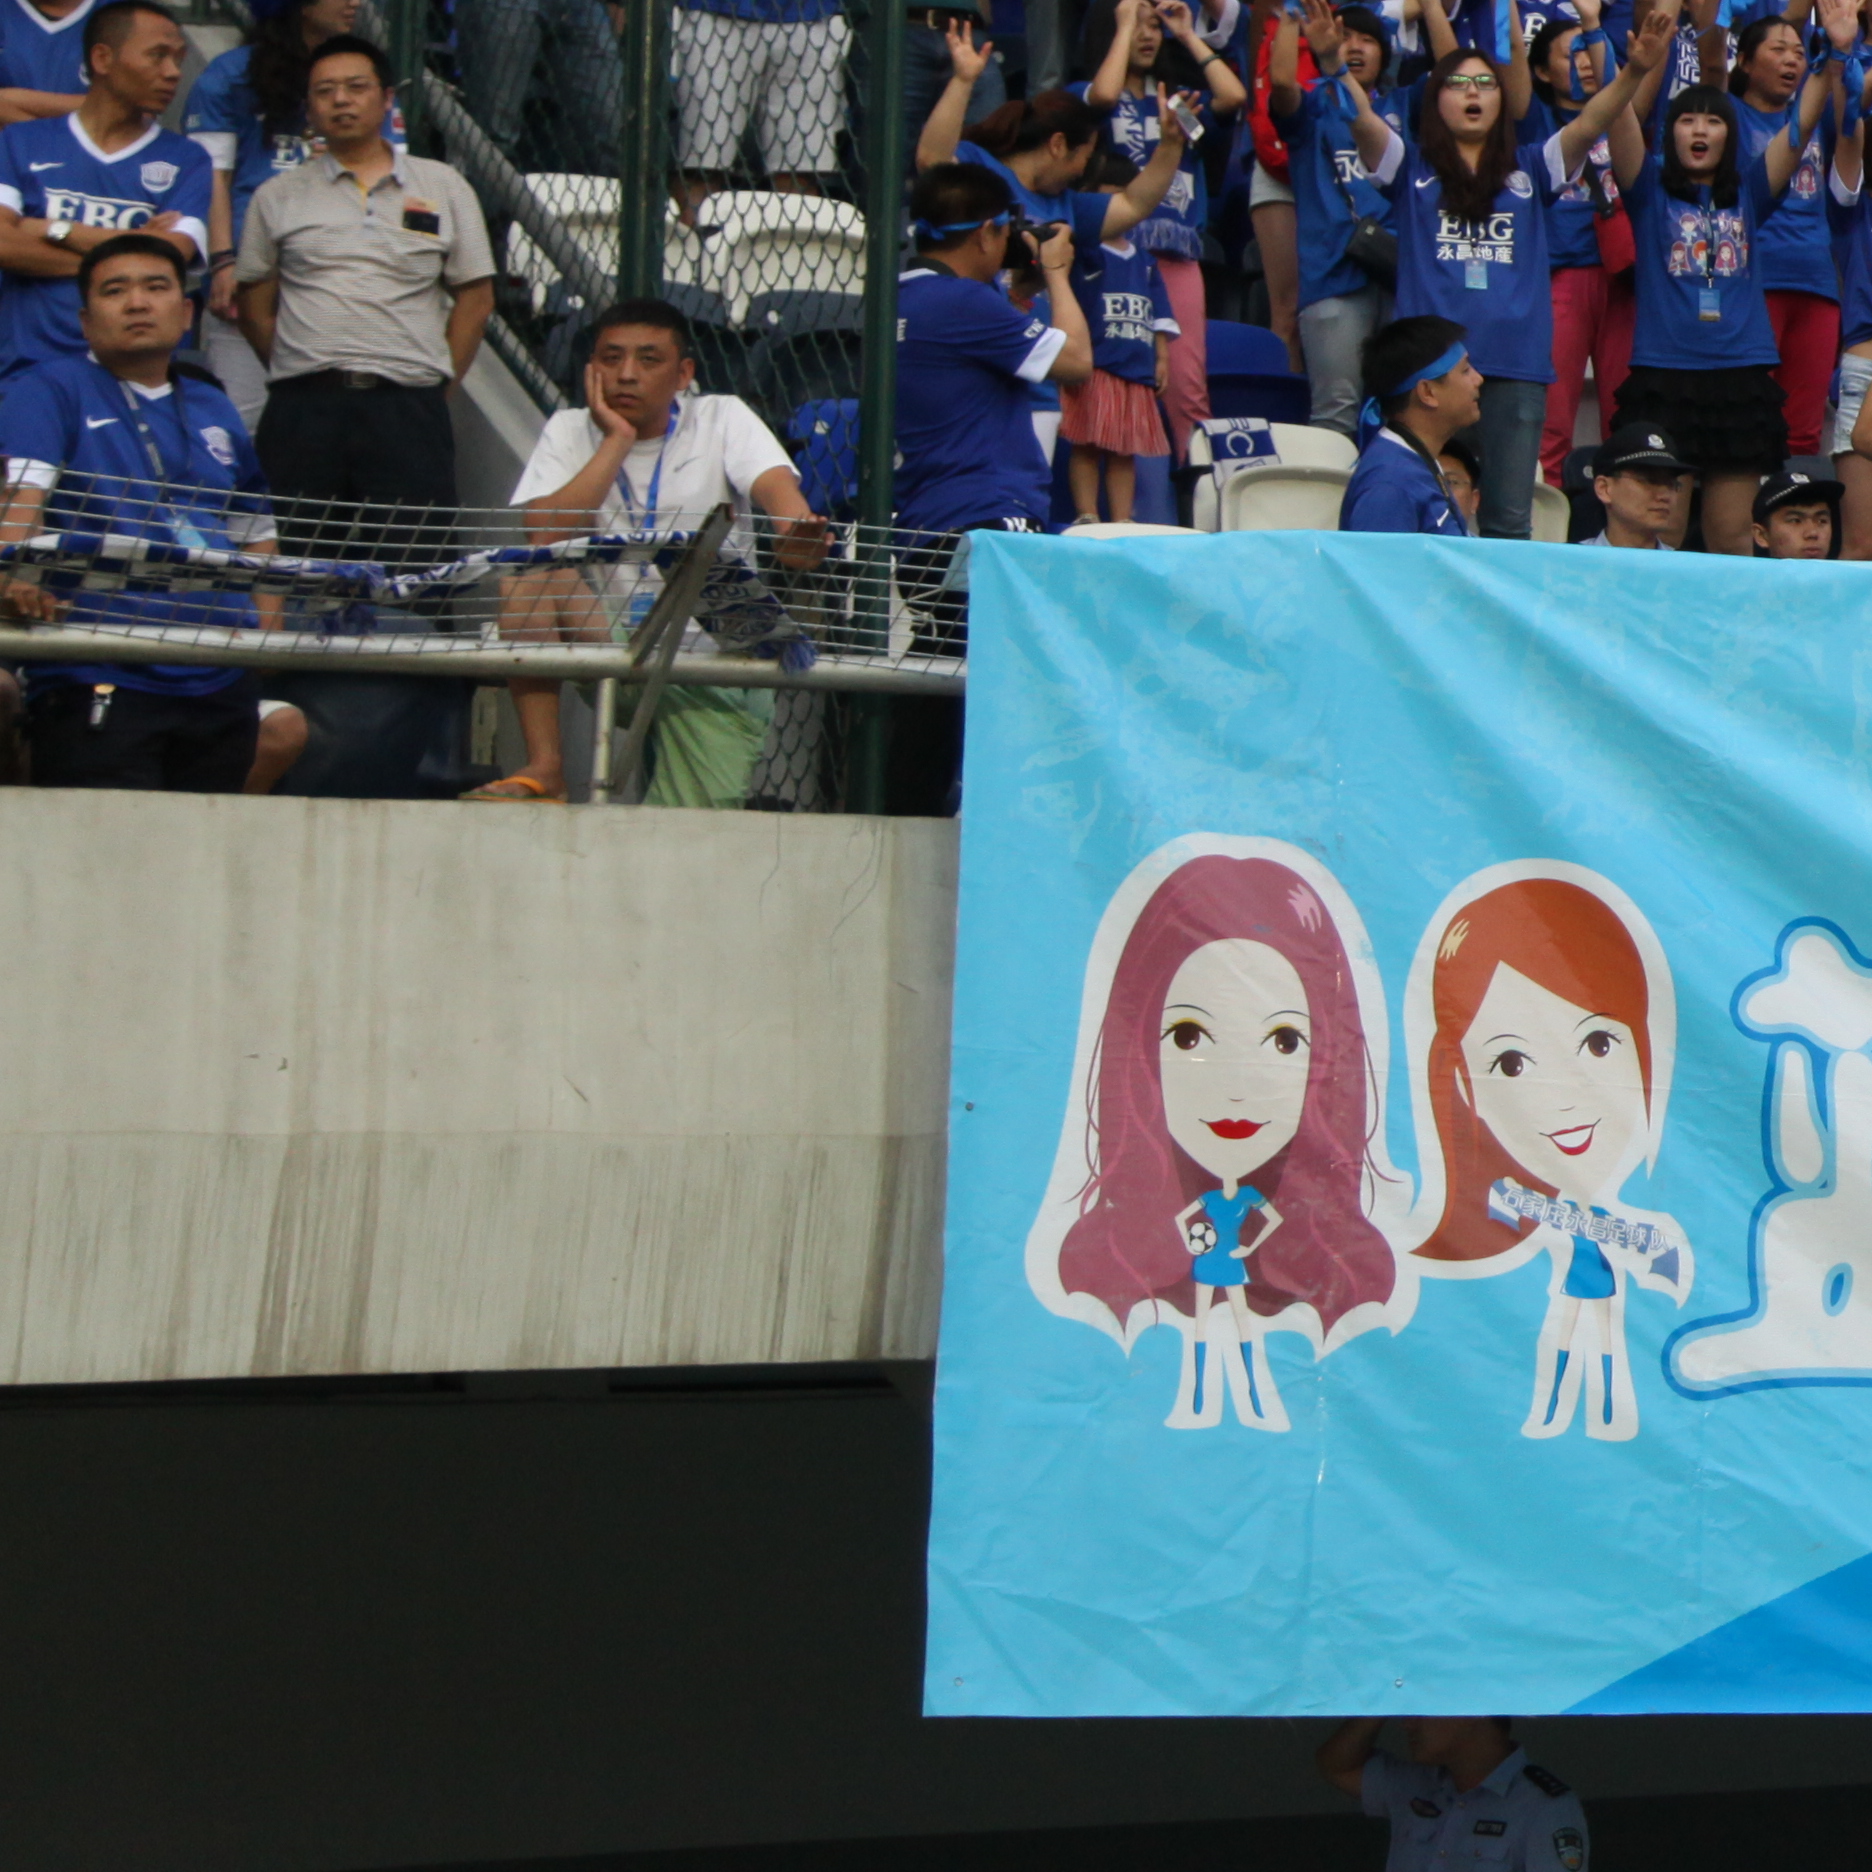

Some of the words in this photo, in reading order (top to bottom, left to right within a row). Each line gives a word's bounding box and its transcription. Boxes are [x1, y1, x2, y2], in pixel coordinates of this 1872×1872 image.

[46, 194, 154, 230] EBG
[1103, 295, 1154, 321] EBG
[1502, 1186, 1670, 1250] 石家庄永昌足球队
